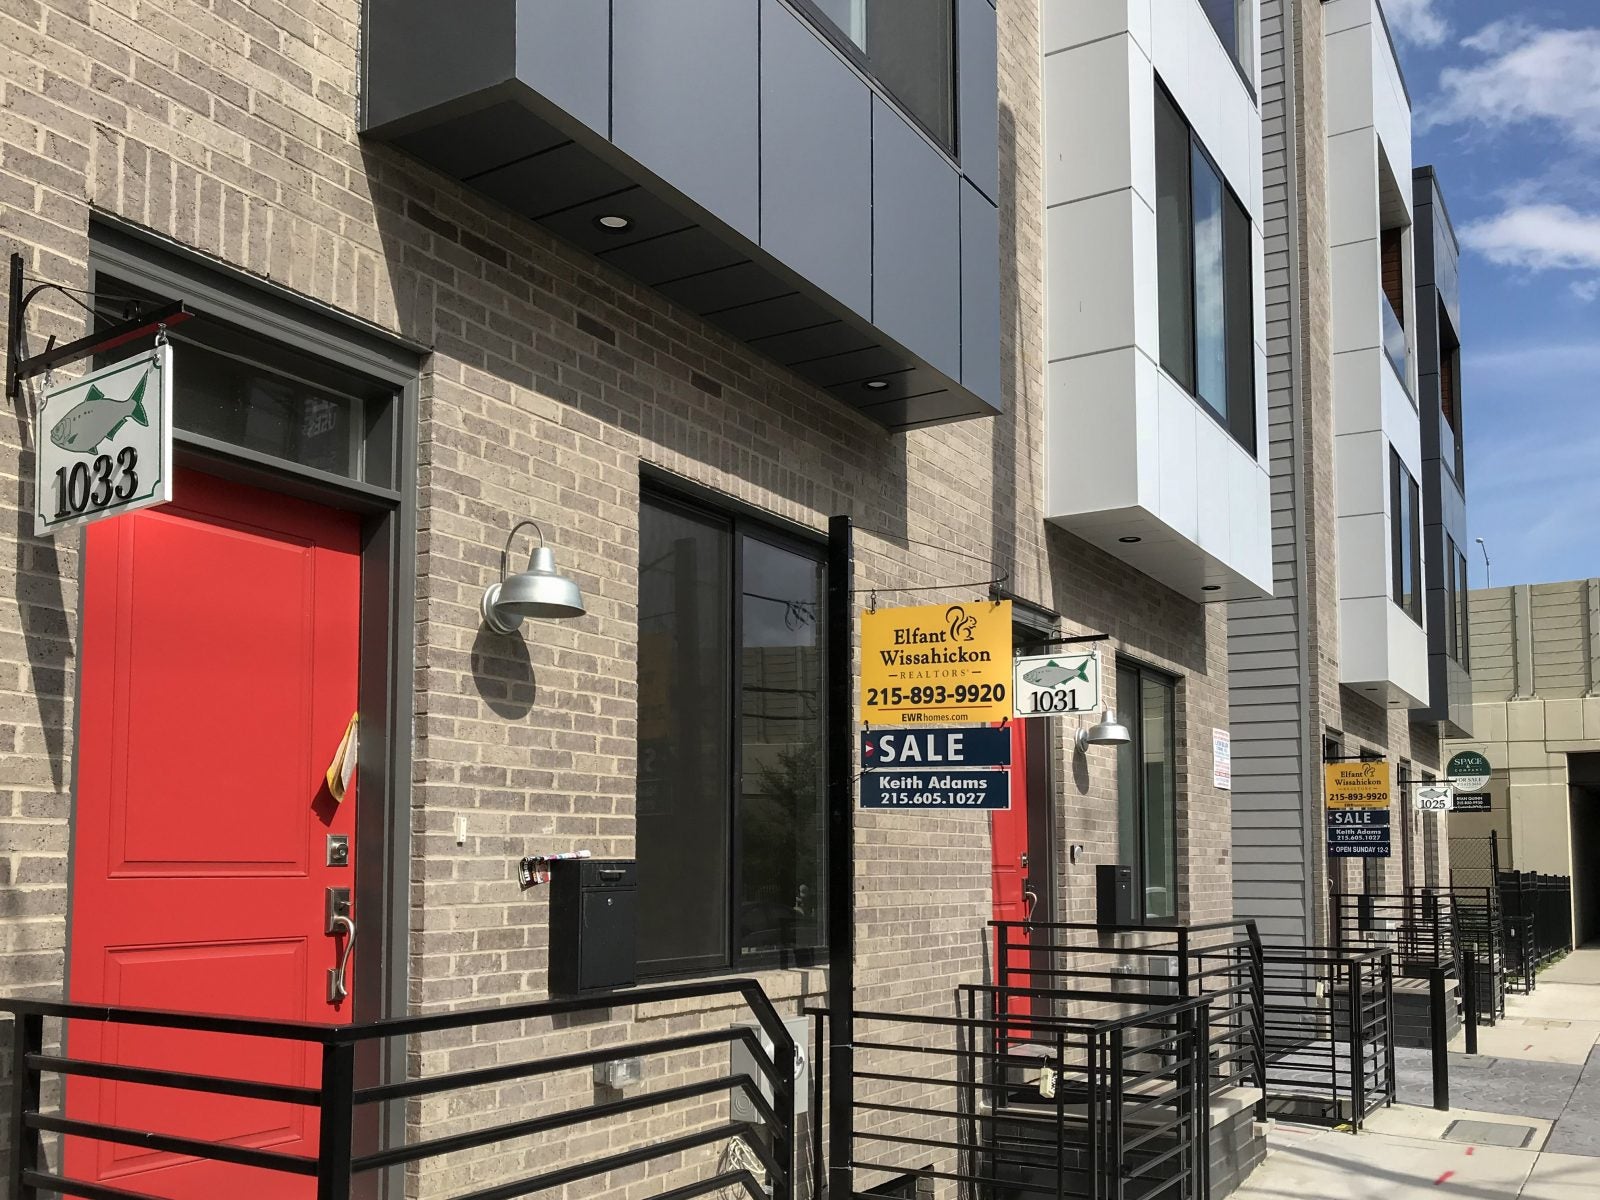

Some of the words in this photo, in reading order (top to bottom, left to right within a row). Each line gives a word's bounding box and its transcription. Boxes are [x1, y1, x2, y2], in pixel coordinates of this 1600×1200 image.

[54, 446, 139, 518] 1033
[894, 628, 946, 645] Elfant
[880, 647, 991, 666] Wissahickon
[867, 684, 1005, 706] 215-893-9920
[1031, 688, 1079, 713] 1031
[879, 733, 964, 763] SALE
[1454, 757, 1482, 766] SPACE
[879, 776, 923, 789] Keith
[928, 775, 988, 789] Adams
[1335, 778, 1381, 786] Wissahickon
[881, 791, 986, 805] 215.605.1027
[1330, 792, 1388, 801] 215-893-9920
[1421, 799, 1445, 809] 1025
[1335, 812, 1371, 823] SALE
